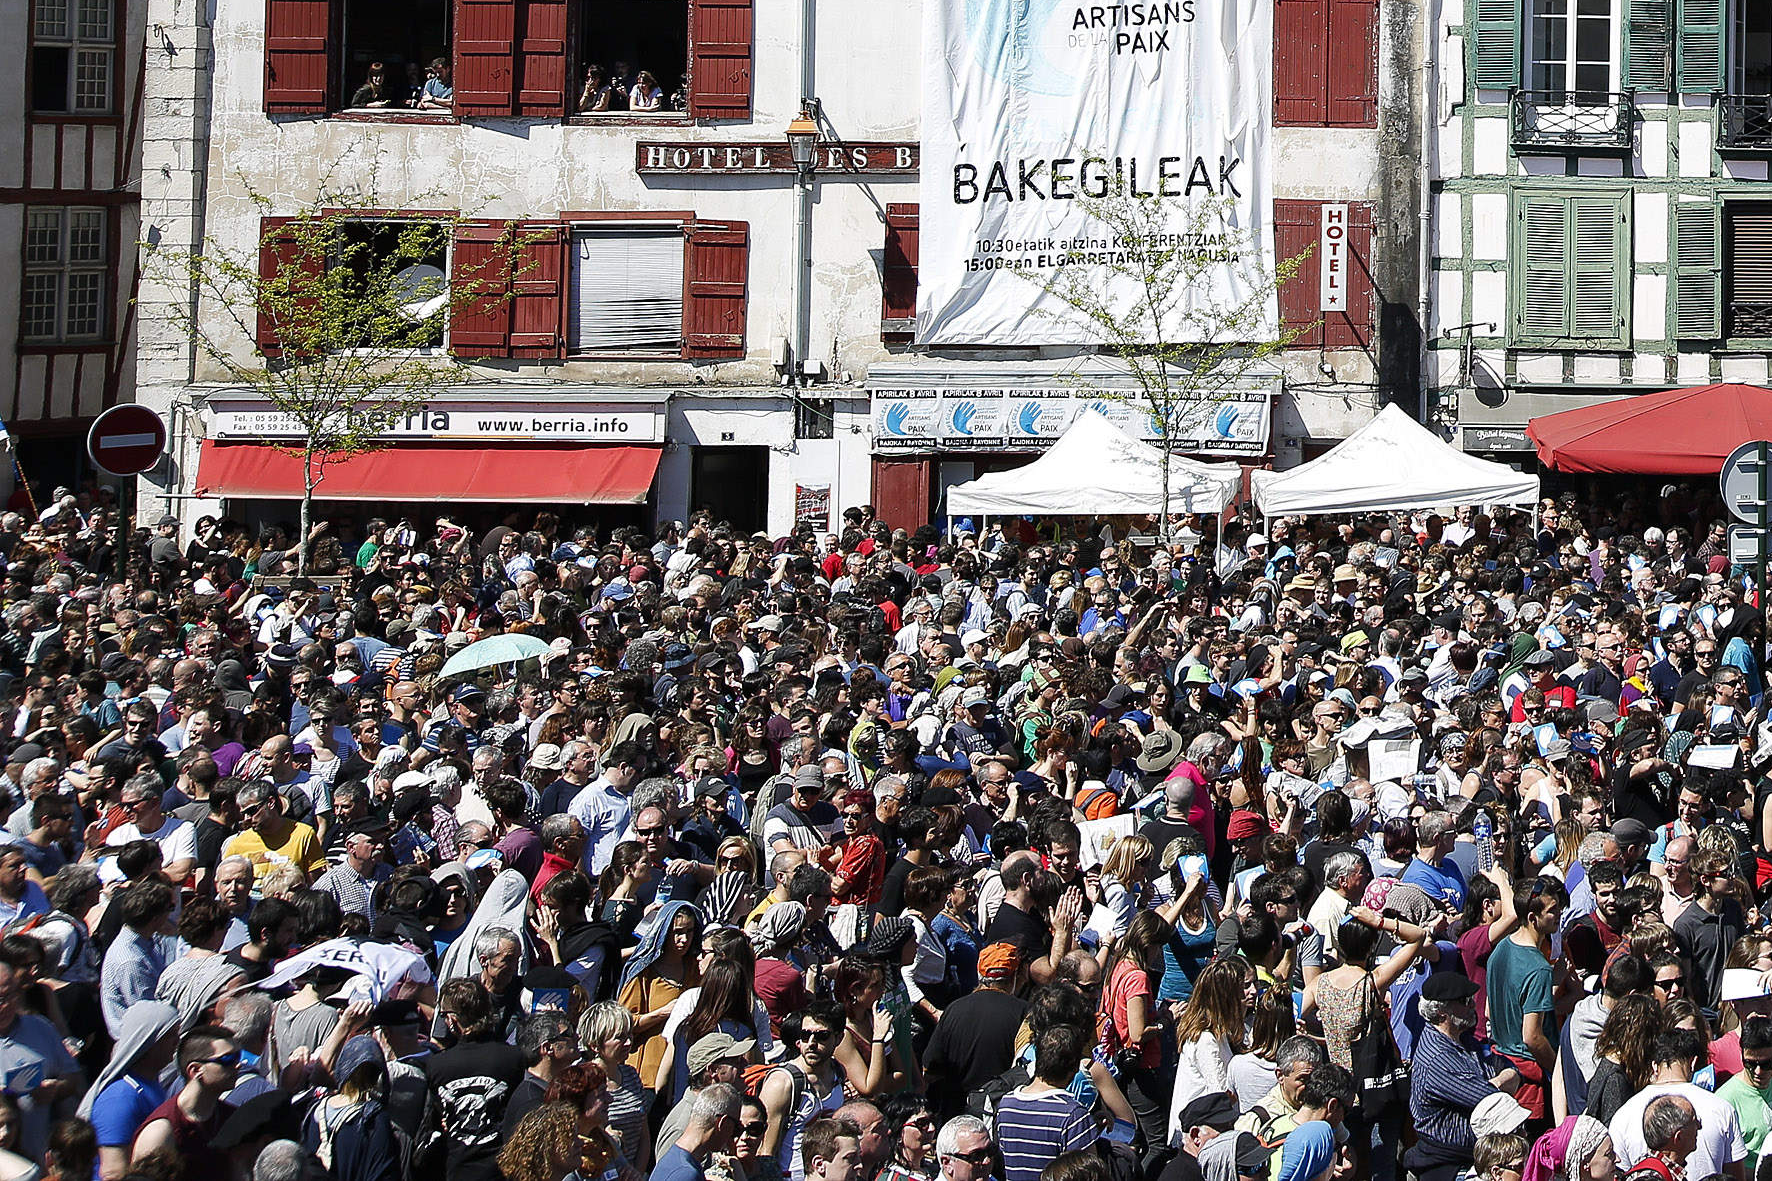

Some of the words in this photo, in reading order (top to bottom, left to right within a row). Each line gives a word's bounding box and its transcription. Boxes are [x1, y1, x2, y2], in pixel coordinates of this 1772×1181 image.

[1072, 0, 1196, 31] ARTISANS
[1116, 29, 1170, 56] PAIX
[645, 145, 772, 169] HOTEL
[812, 146, 869, 169] ES
[952, 155, 1242, 205] BAKEGILEAK
[1326, 210, 1344, 289] HOTEL
[255, 423, 265, 431] 05
[267, 423, 278, 431] 59
[279, 423, 290, 431] 25
[477, 417, 629, 433] www.berria.info
[974, 424, 993, 432] PAIX
[1040, 424, 1059, 432] PAIX
